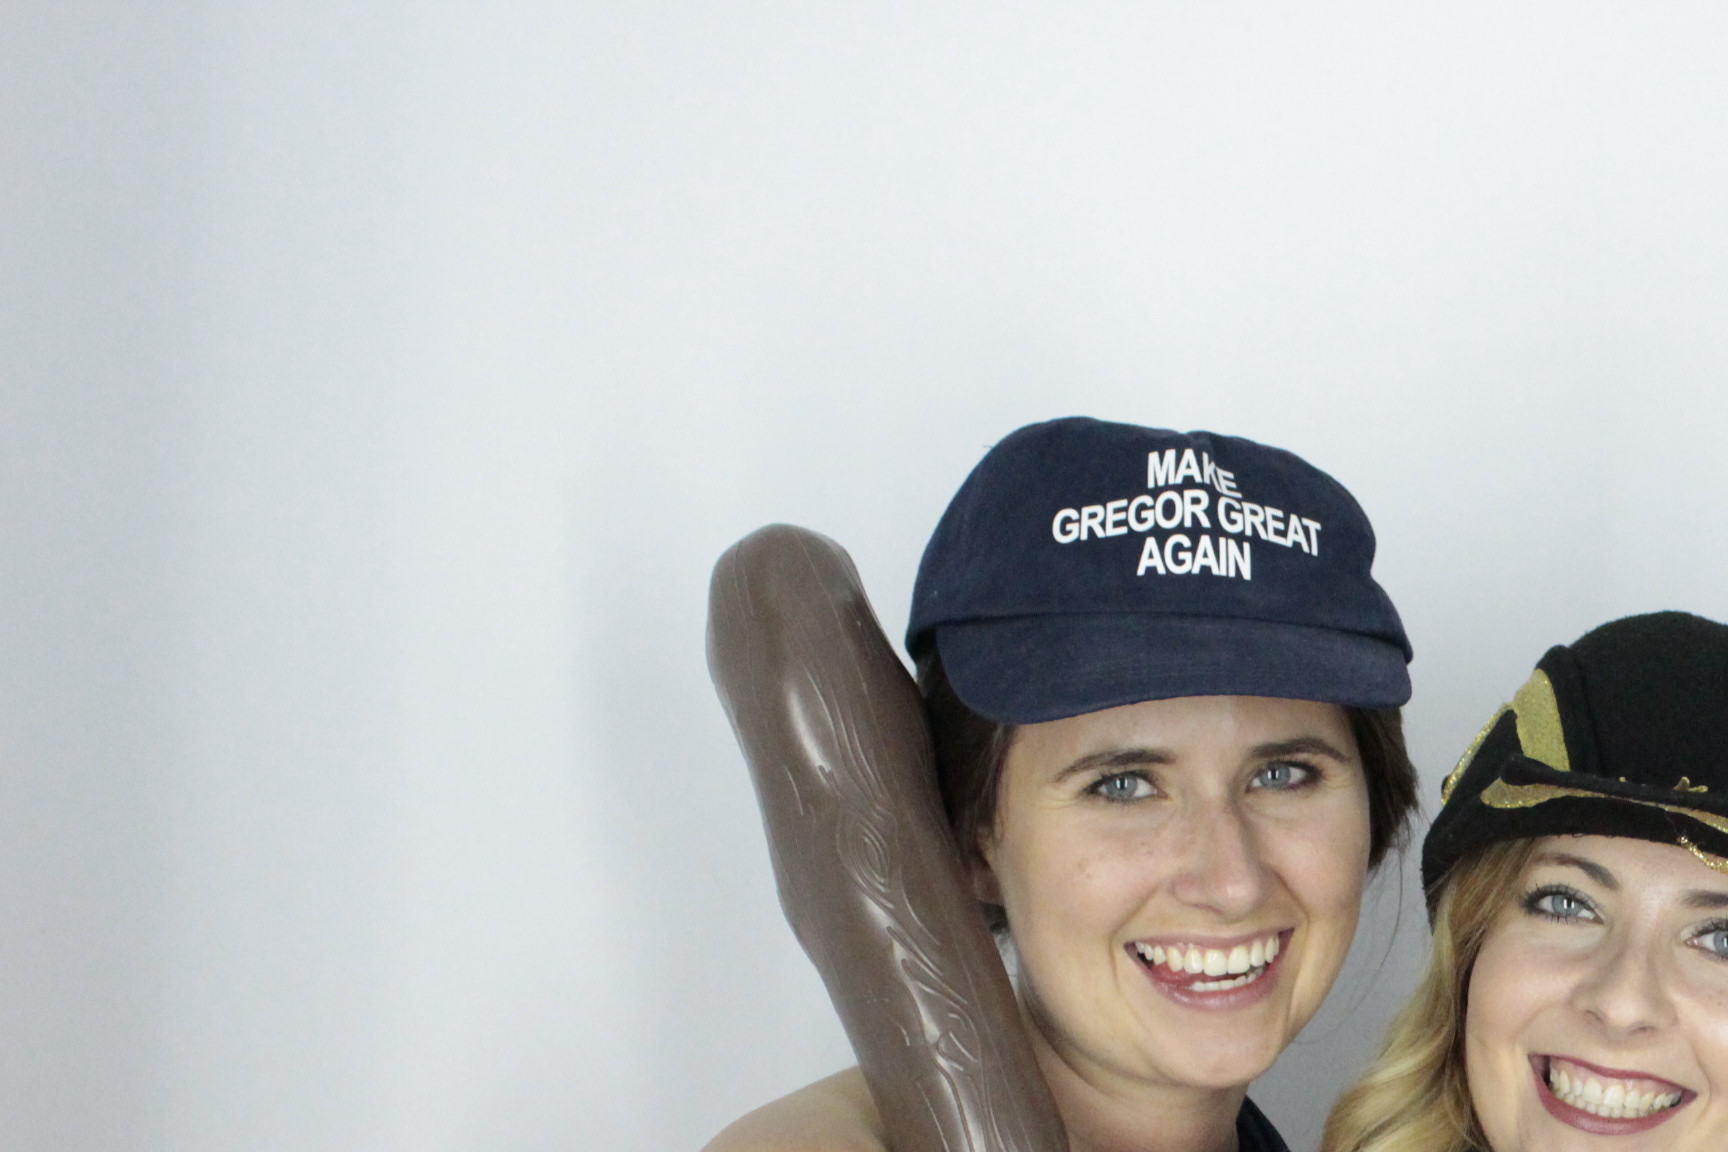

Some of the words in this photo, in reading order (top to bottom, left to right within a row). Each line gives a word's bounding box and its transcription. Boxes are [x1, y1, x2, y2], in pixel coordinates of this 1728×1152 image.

[1147, 448, 1242, 499] MAKE
[1052, 489, 1211, 545] GREGOR
[1217, 496, 1321, 556] GREAT
[1137, 534, 1251, 581] AGAIN
